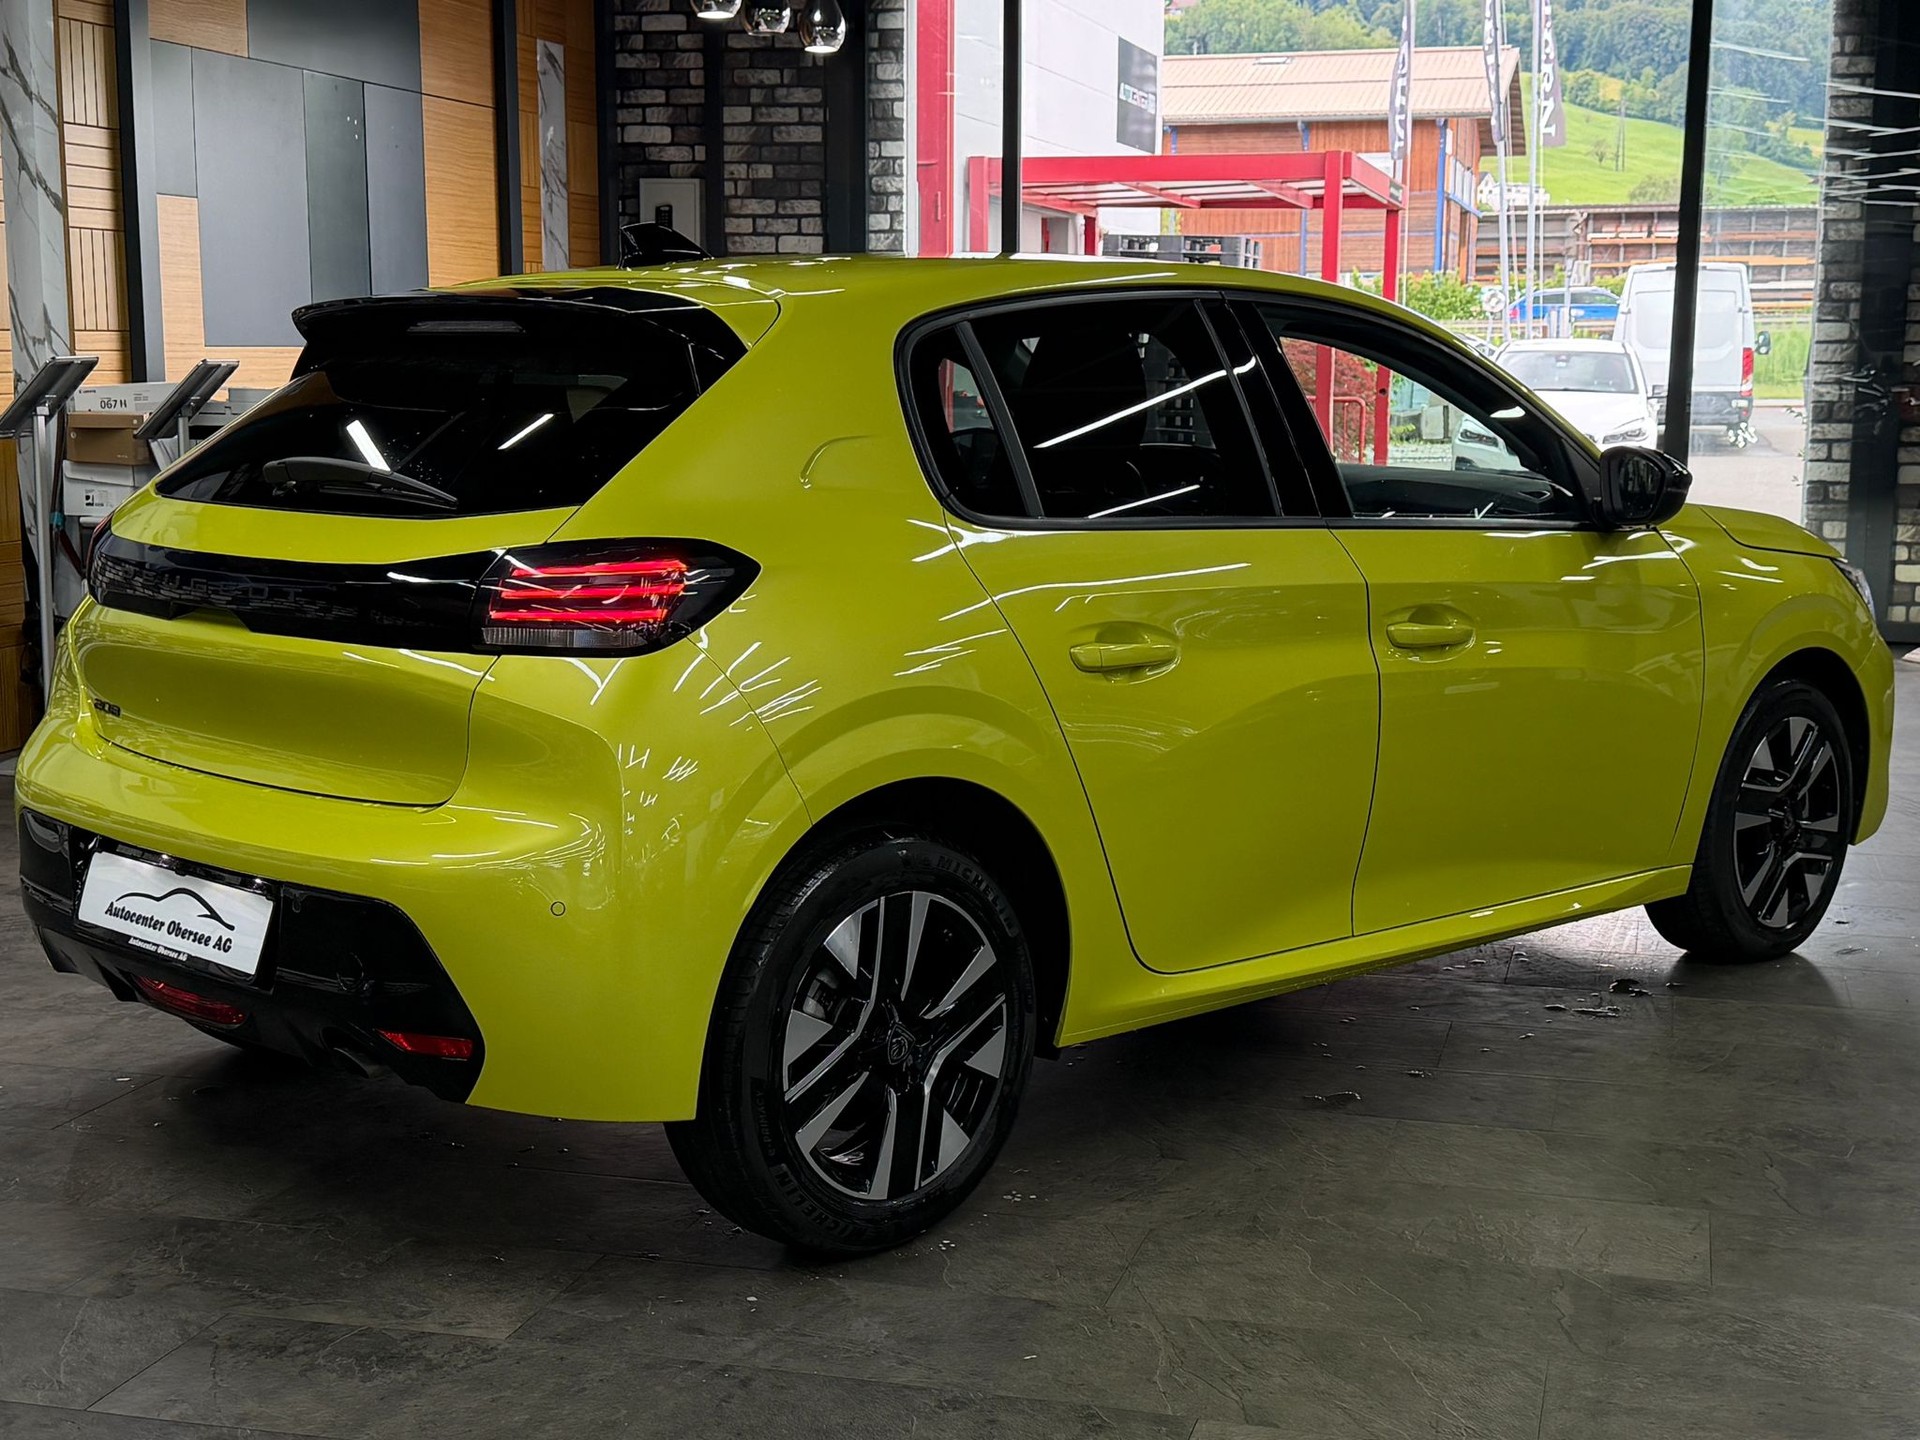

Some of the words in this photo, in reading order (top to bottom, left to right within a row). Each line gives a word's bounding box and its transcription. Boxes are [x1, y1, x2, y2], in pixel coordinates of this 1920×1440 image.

[100, 399, 118, 409] 067
[122, 568, 303, 602] PEUGEOT
[94, 698, 121, 717] 208
[105, 901, 165, 933] Autocenter
[167, 920, 211, 947] Obersee
[213, 935, 233, 953] AG
[128, 937, 157, 953] Autocenter
[157, 945, 178, 959] Obersee
[177, 952, 188, 962] AG
